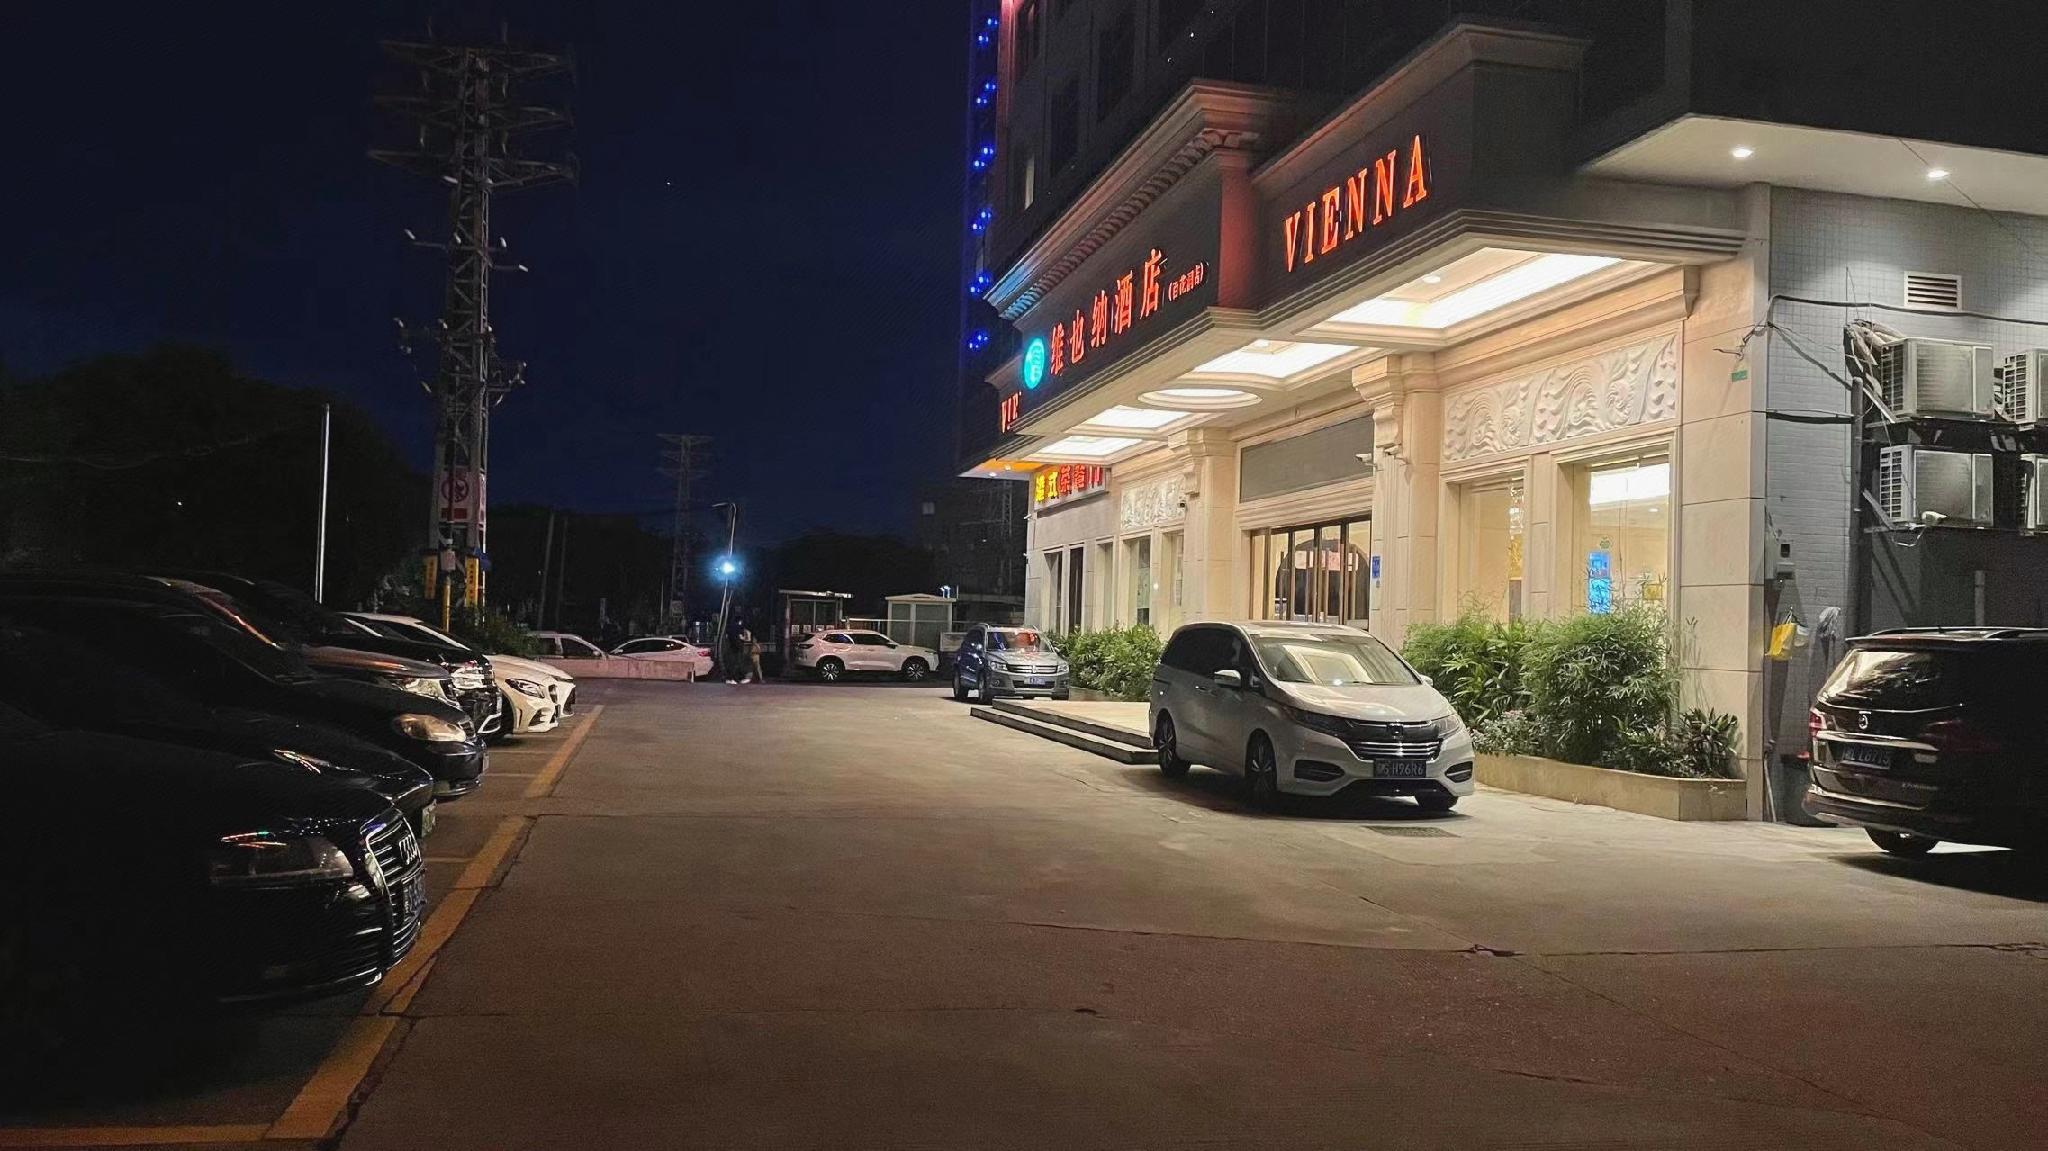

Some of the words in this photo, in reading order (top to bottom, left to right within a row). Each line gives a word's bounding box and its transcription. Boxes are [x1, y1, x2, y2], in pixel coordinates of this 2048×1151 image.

[1284, 134, 1428, 273] VIENNA
[1050, 247, 1163, 376] 维也纳酒店
